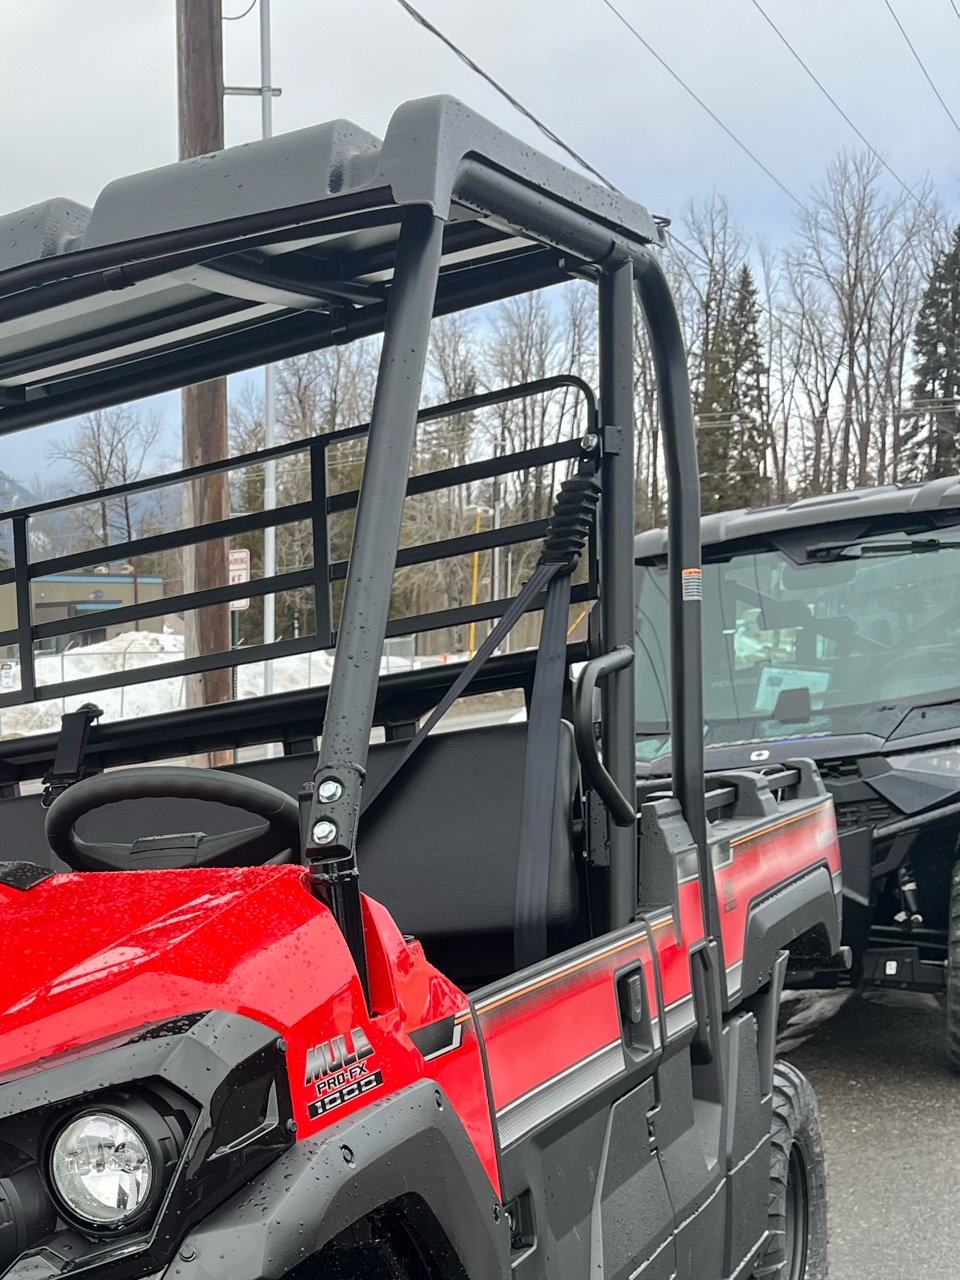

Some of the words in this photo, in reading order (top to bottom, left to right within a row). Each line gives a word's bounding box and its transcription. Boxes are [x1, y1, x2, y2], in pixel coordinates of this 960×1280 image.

[305, 1026, 375, 1086] MULE
[313, 1073, 378, 1115] 1000
[316, 1061, 369, 1096] PRO-FX
